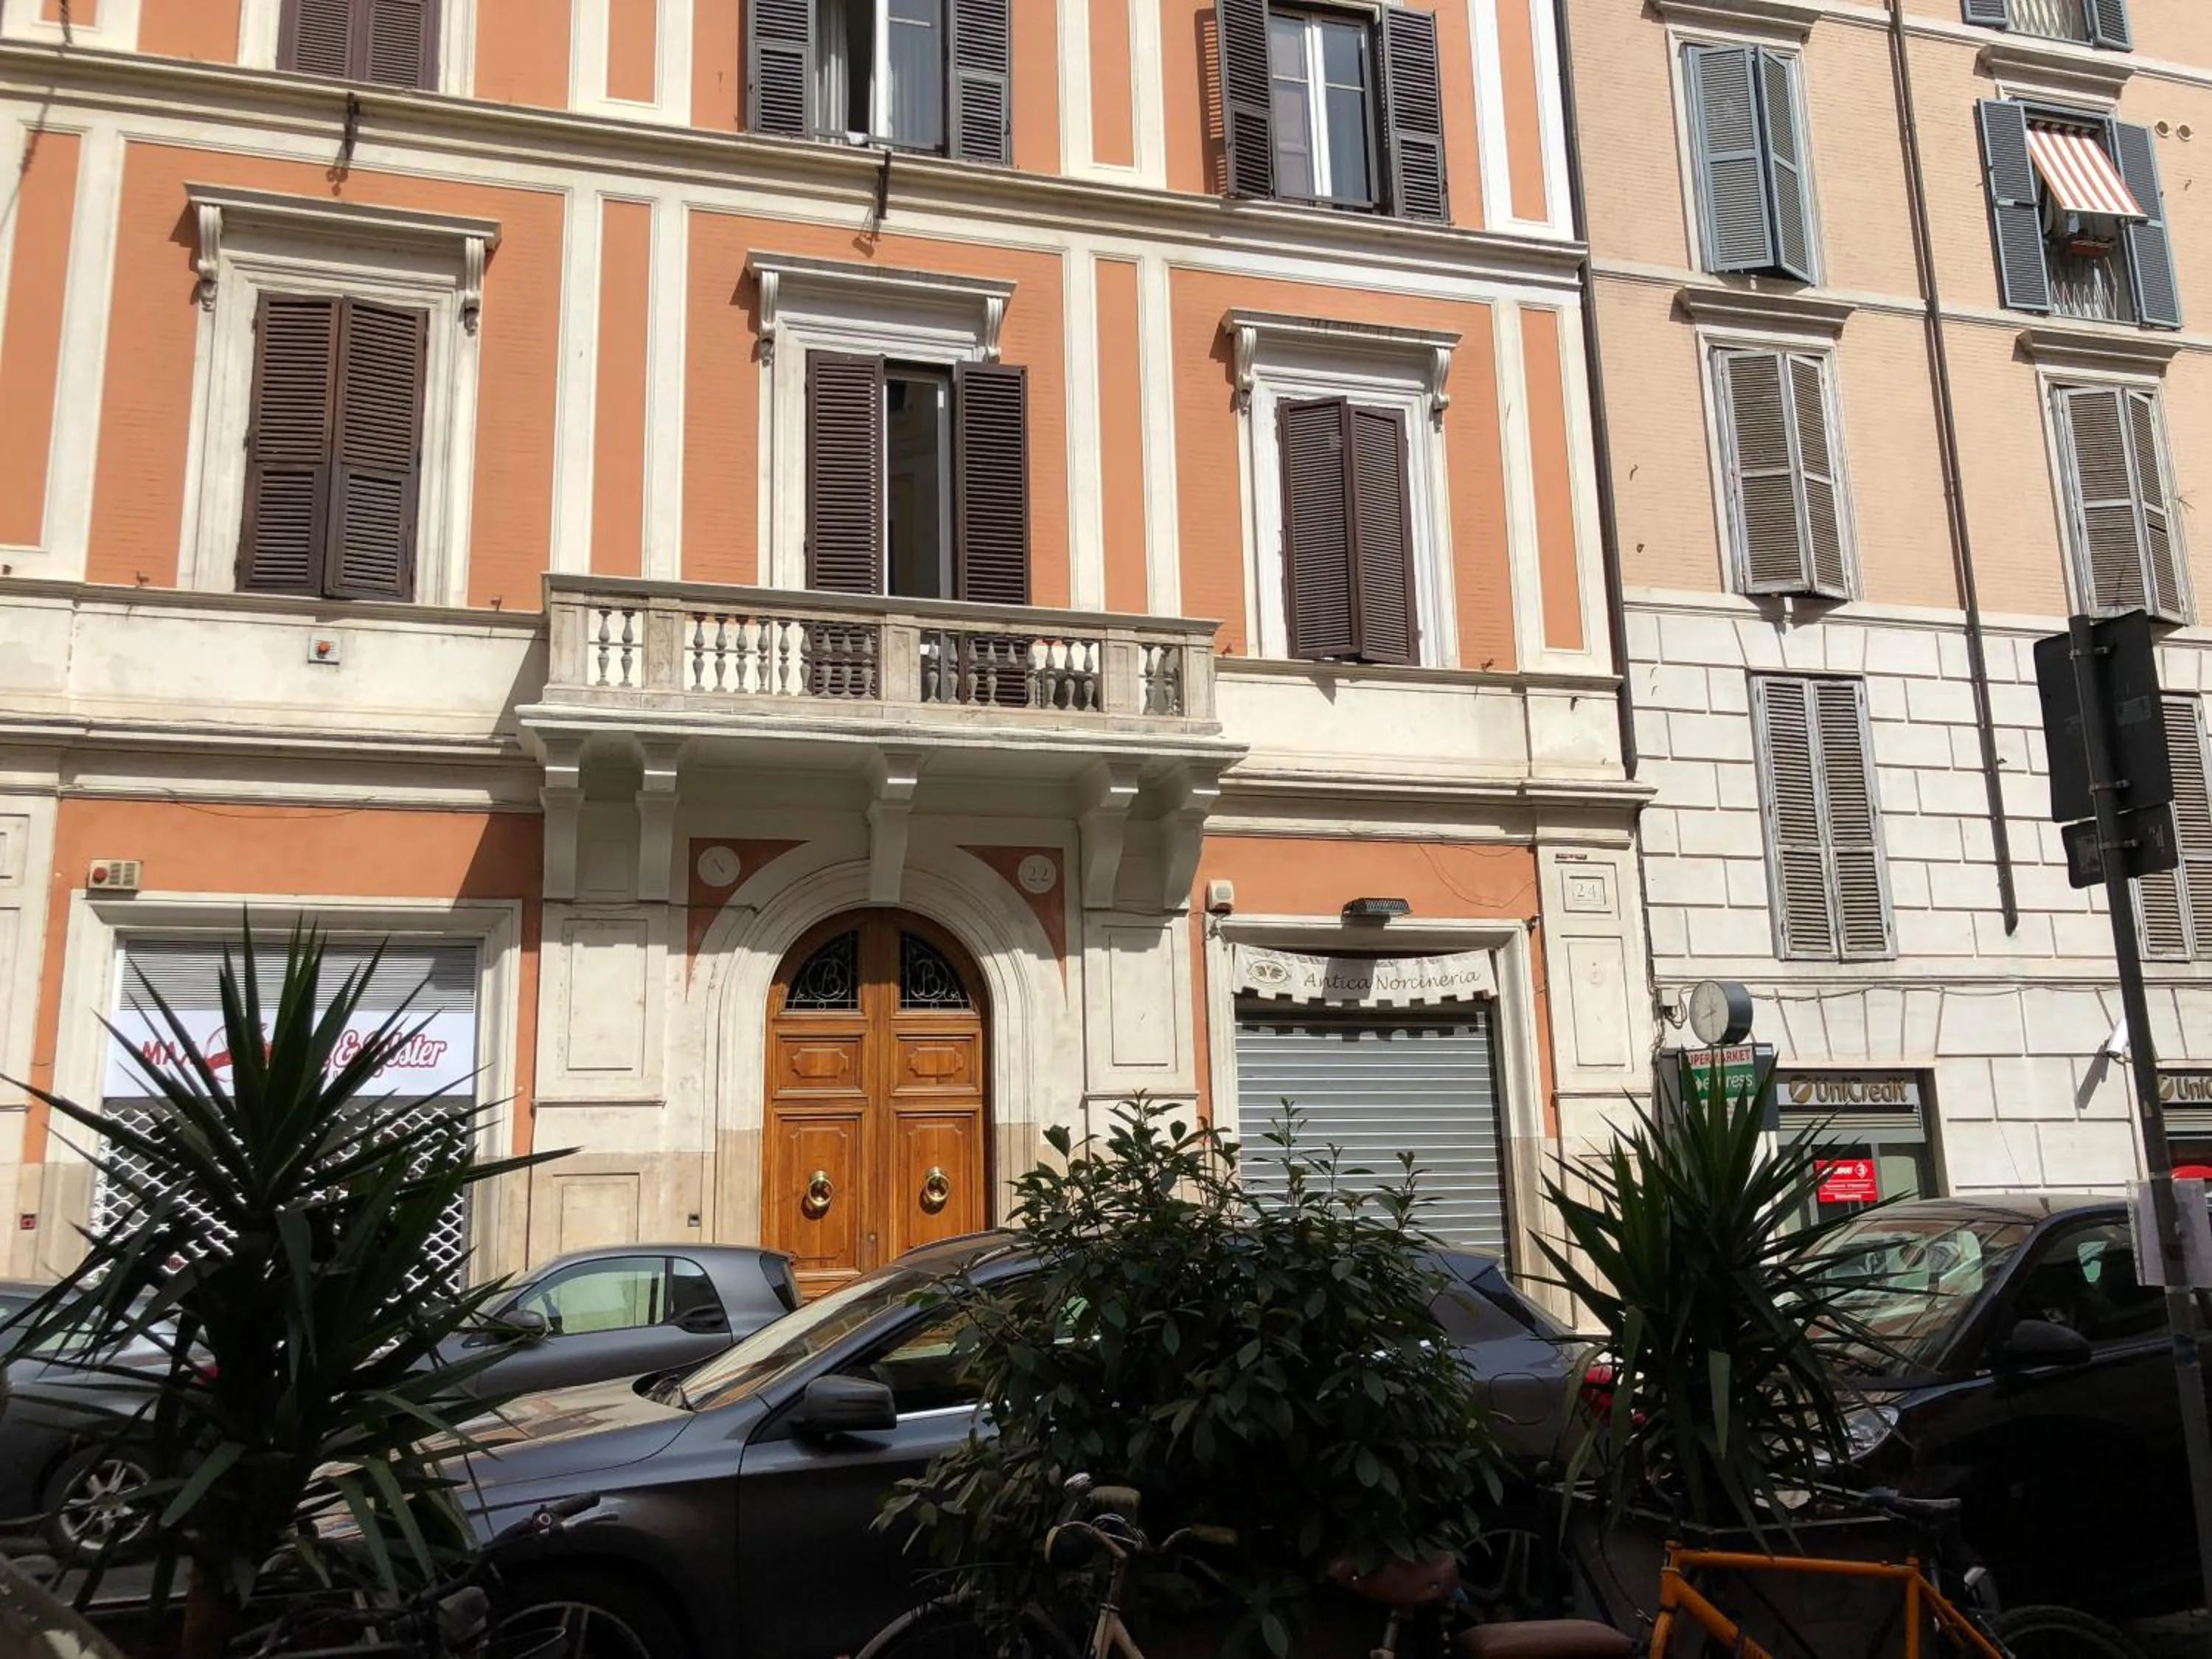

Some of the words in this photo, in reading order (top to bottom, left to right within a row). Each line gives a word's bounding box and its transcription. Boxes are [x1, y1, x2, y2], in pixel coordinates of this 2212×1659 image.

[1304, 971, 1372, 990] Antica
[1375, 969, 1481, 991] Norcineria
[142, 1040, 198, 1065] MA
[364, 1030, 448, 1078] bster
[1688, 1049, 1750, 1065] UPERARKET
[1703, 1074, 1753, 1091] eress
[1816, 1079, 1907, 1103] UniCredit
